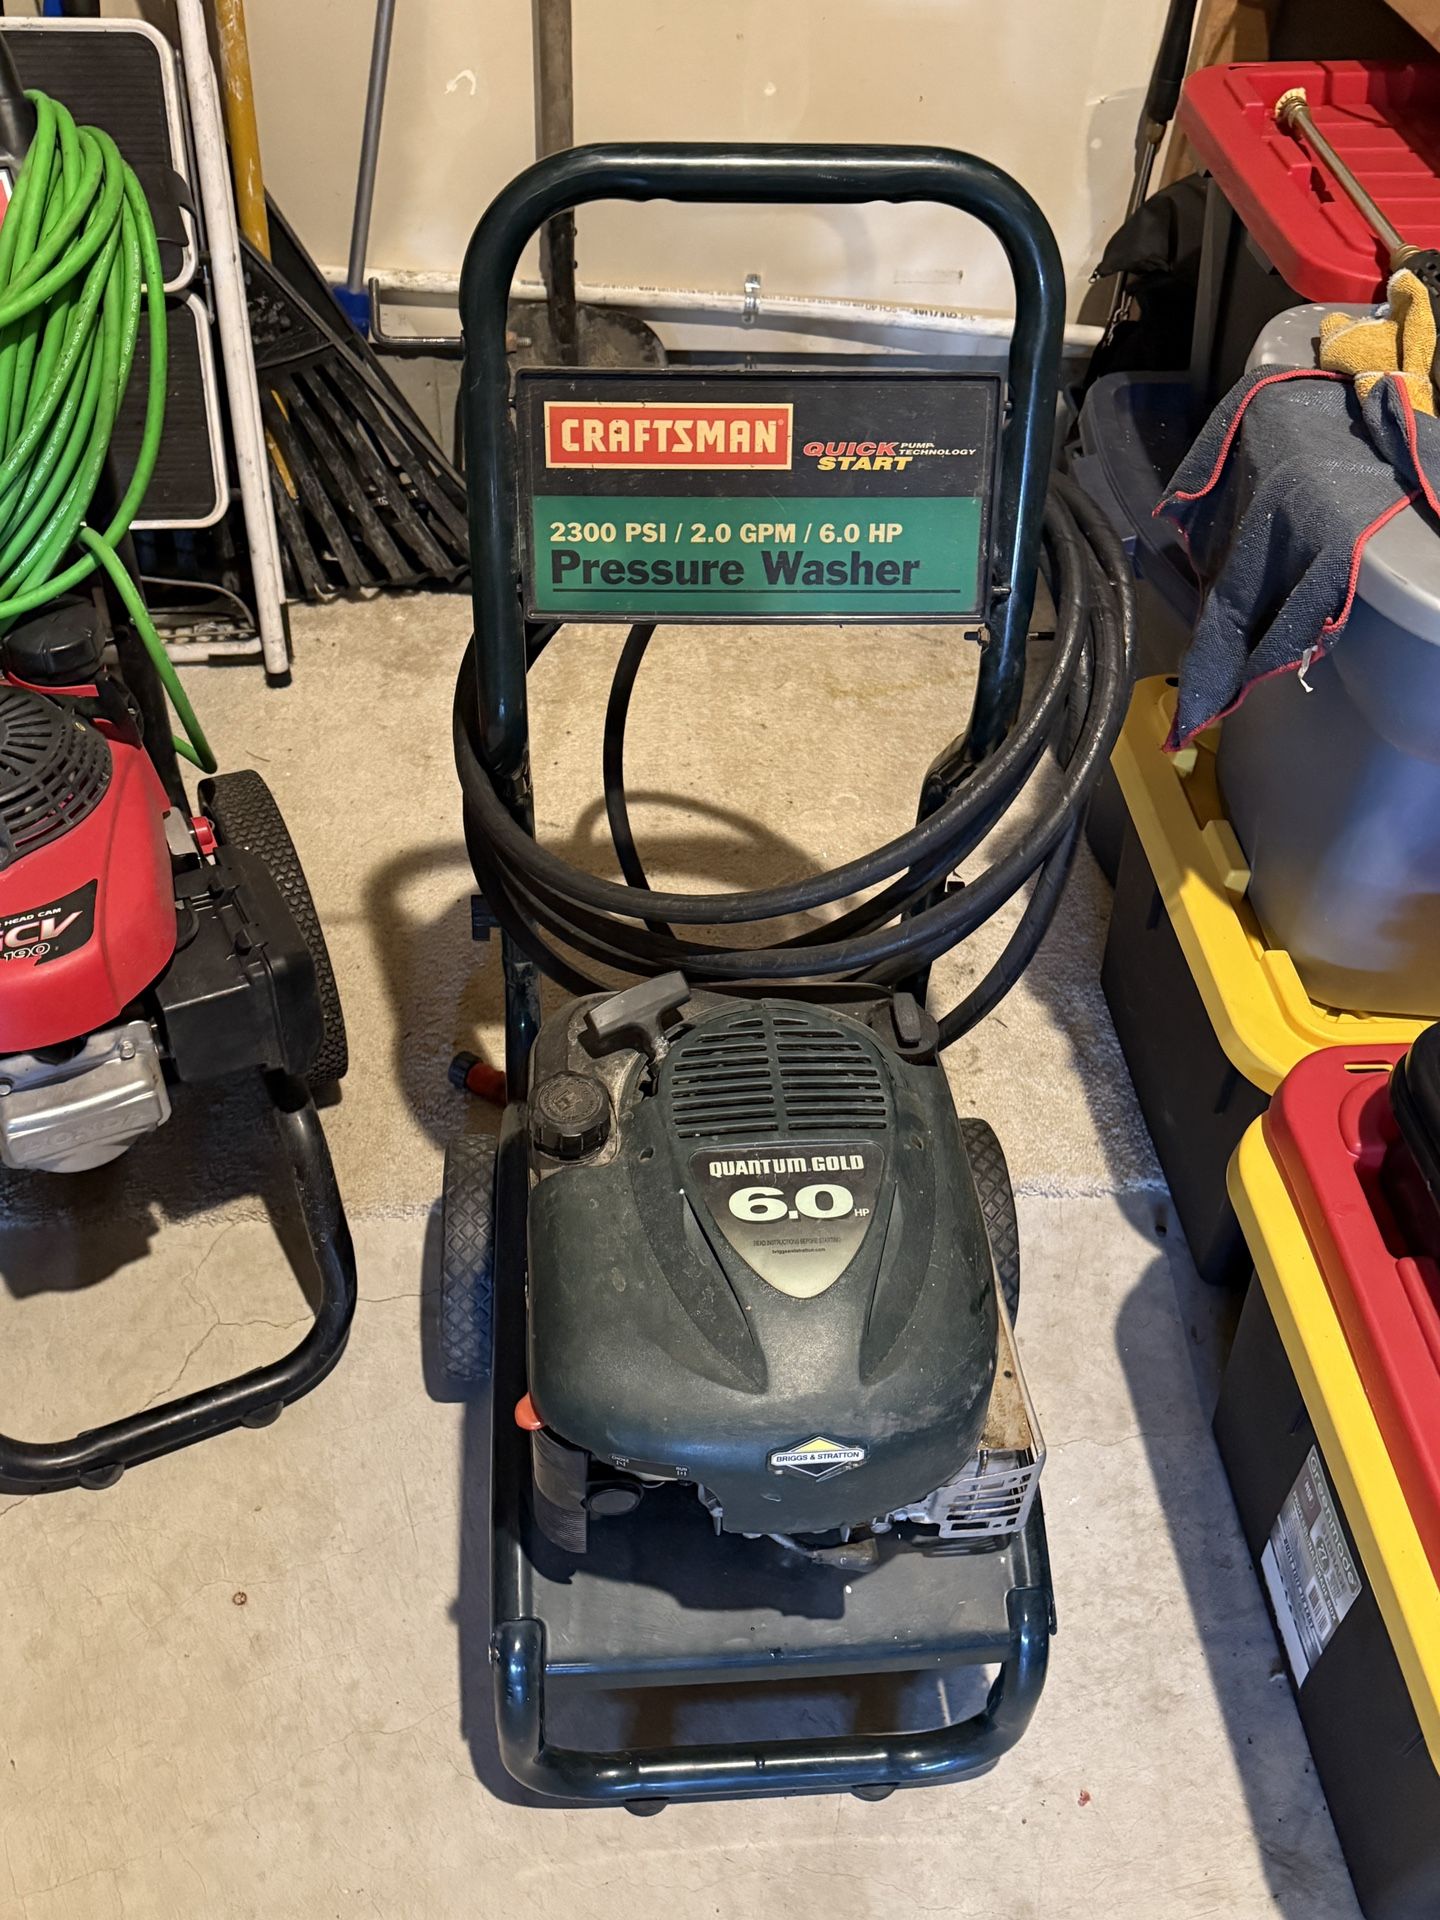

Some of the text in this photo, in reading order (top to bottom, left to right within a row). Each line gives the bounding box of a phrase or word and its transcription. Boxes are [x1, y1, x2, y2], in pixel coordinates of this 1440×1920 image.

[130, 292, 139, 311] FROM
[561, 419, 777, 453] CRAFTSMAN
[803, 441, 897, 457] QUICK
[897, 447, 977, 456] TECHNOLOGY
[817, 456, 912, 471] START
[549, 522, 903, 544] 2300 PSI / 2.0 GPM / 6.0 HP
[551, 549, 921, 586] Pressure Washer
[4, 907, 62, 926] HEAD CAM
[709, 1155, 864, 1177] QUANTUM GOLD
[729, 1184, 869, 1222] 6.0 HP
[1310, 1456, 1356, 1586] Greenmade
[1317, 1542, 1328, 1563] 27
[1326, 1597, 1336, 1623] BOX
